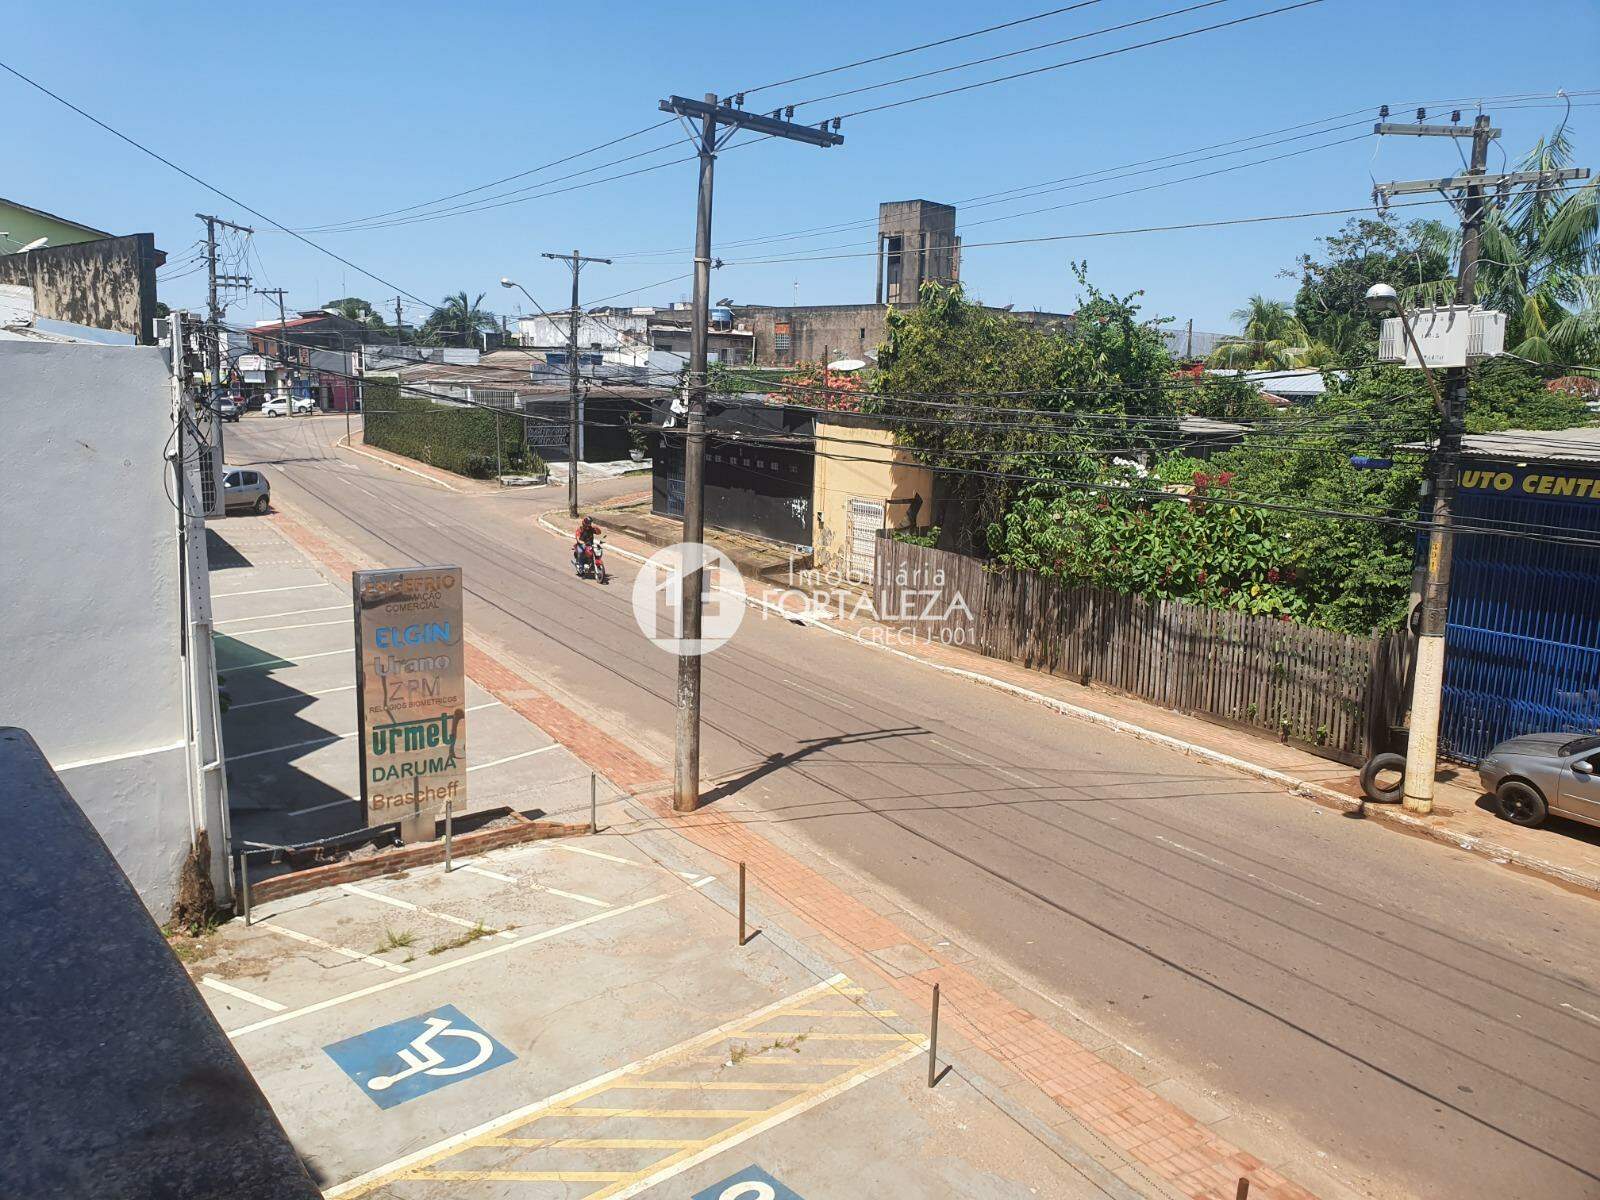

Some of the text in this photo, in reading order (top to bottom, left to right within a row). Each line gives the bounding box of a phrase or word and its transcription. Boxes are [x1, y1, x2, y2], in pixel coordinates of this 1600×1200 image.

[1458, 470, 1513, 491] UTO
[385, 601, 440, 612] COMERCIAL
[376, 622, 449, 648] ELGIN
[374, 655, 449, 676] Urano
[389, 678, 440, 701] ZPM
[372, 712, 456, 756] urmet
[372, 757, 457, 783] DARUMA
[373, 781, 459, 811] Brascheff
